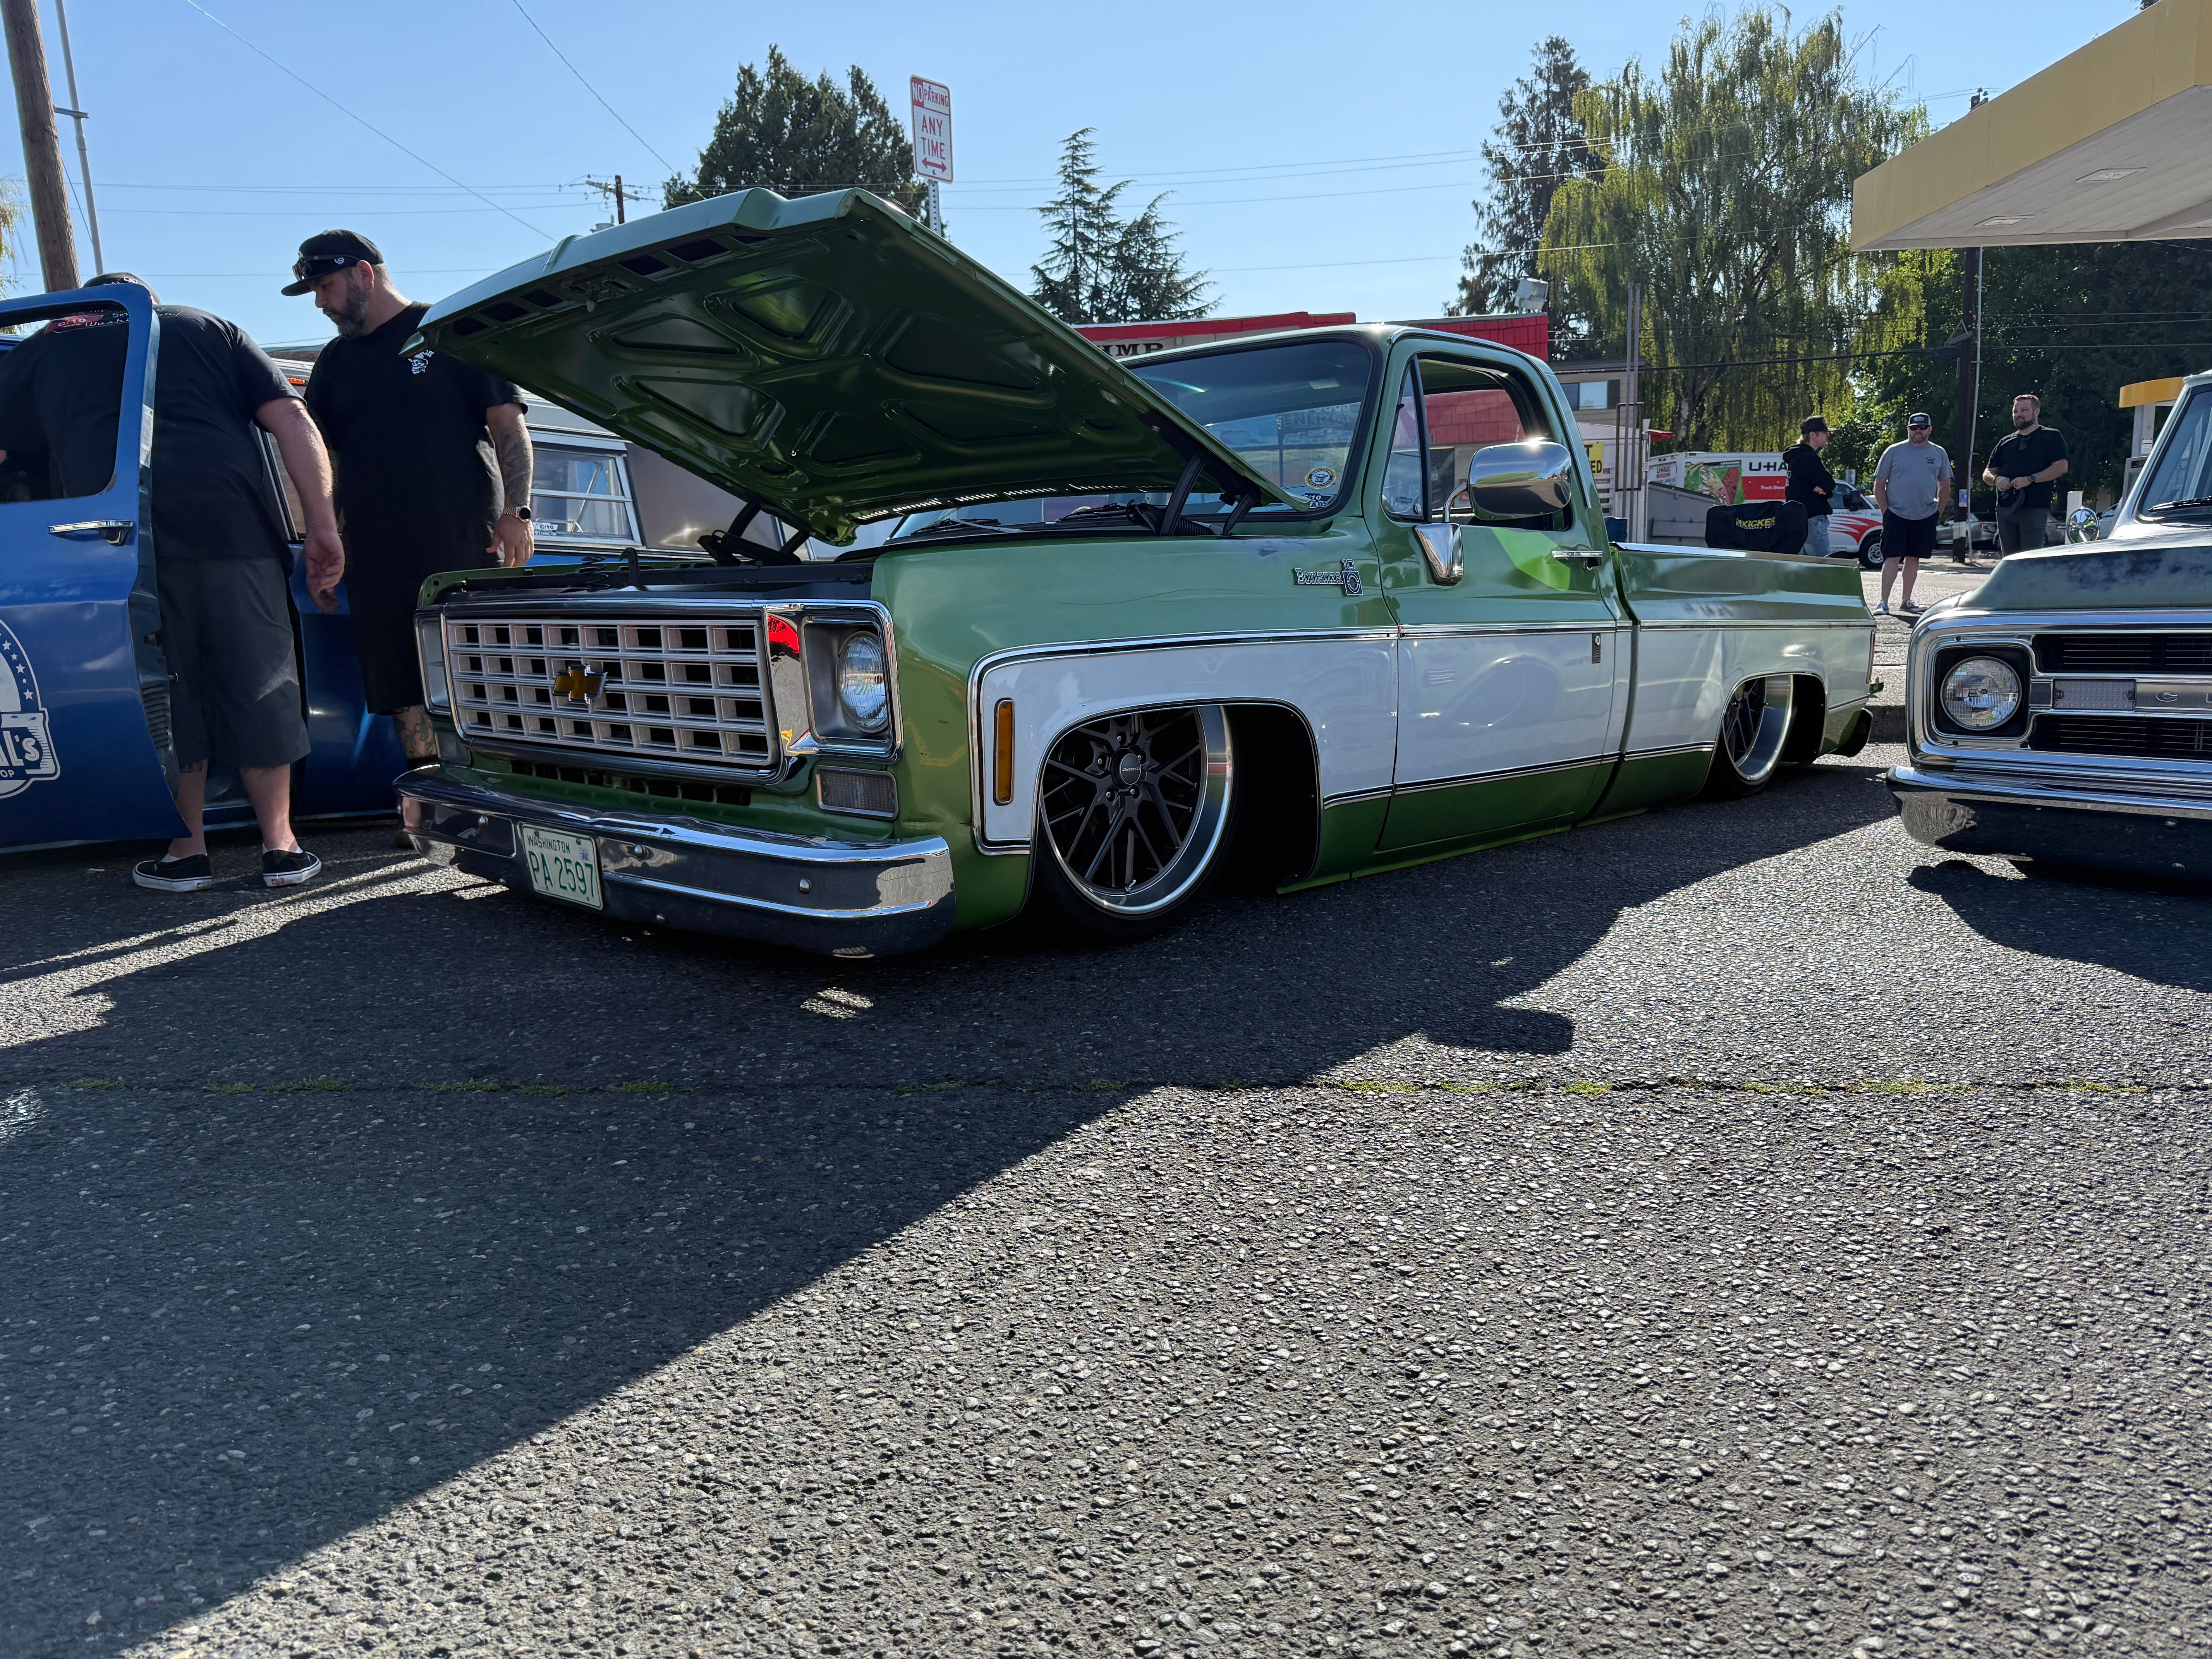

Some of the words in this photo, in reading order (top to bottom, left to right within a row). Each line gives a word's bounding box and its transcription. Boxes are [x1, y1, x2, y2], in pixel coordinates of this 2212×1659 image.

[912, 82, 923, 102] NO
[924, 88, 948, 107] PARKING
[922, 115, 943, 137] ANY
[921, 136, 945, 160] TIME
[1342, 559, 1355, 570] 10
[1295, 568, 1344, 584] Bonanza
[527, 835, 570, 854] WASHINGTON
[528, 850, 553, 890] PA
[554, 856, 594, 897] 2597
